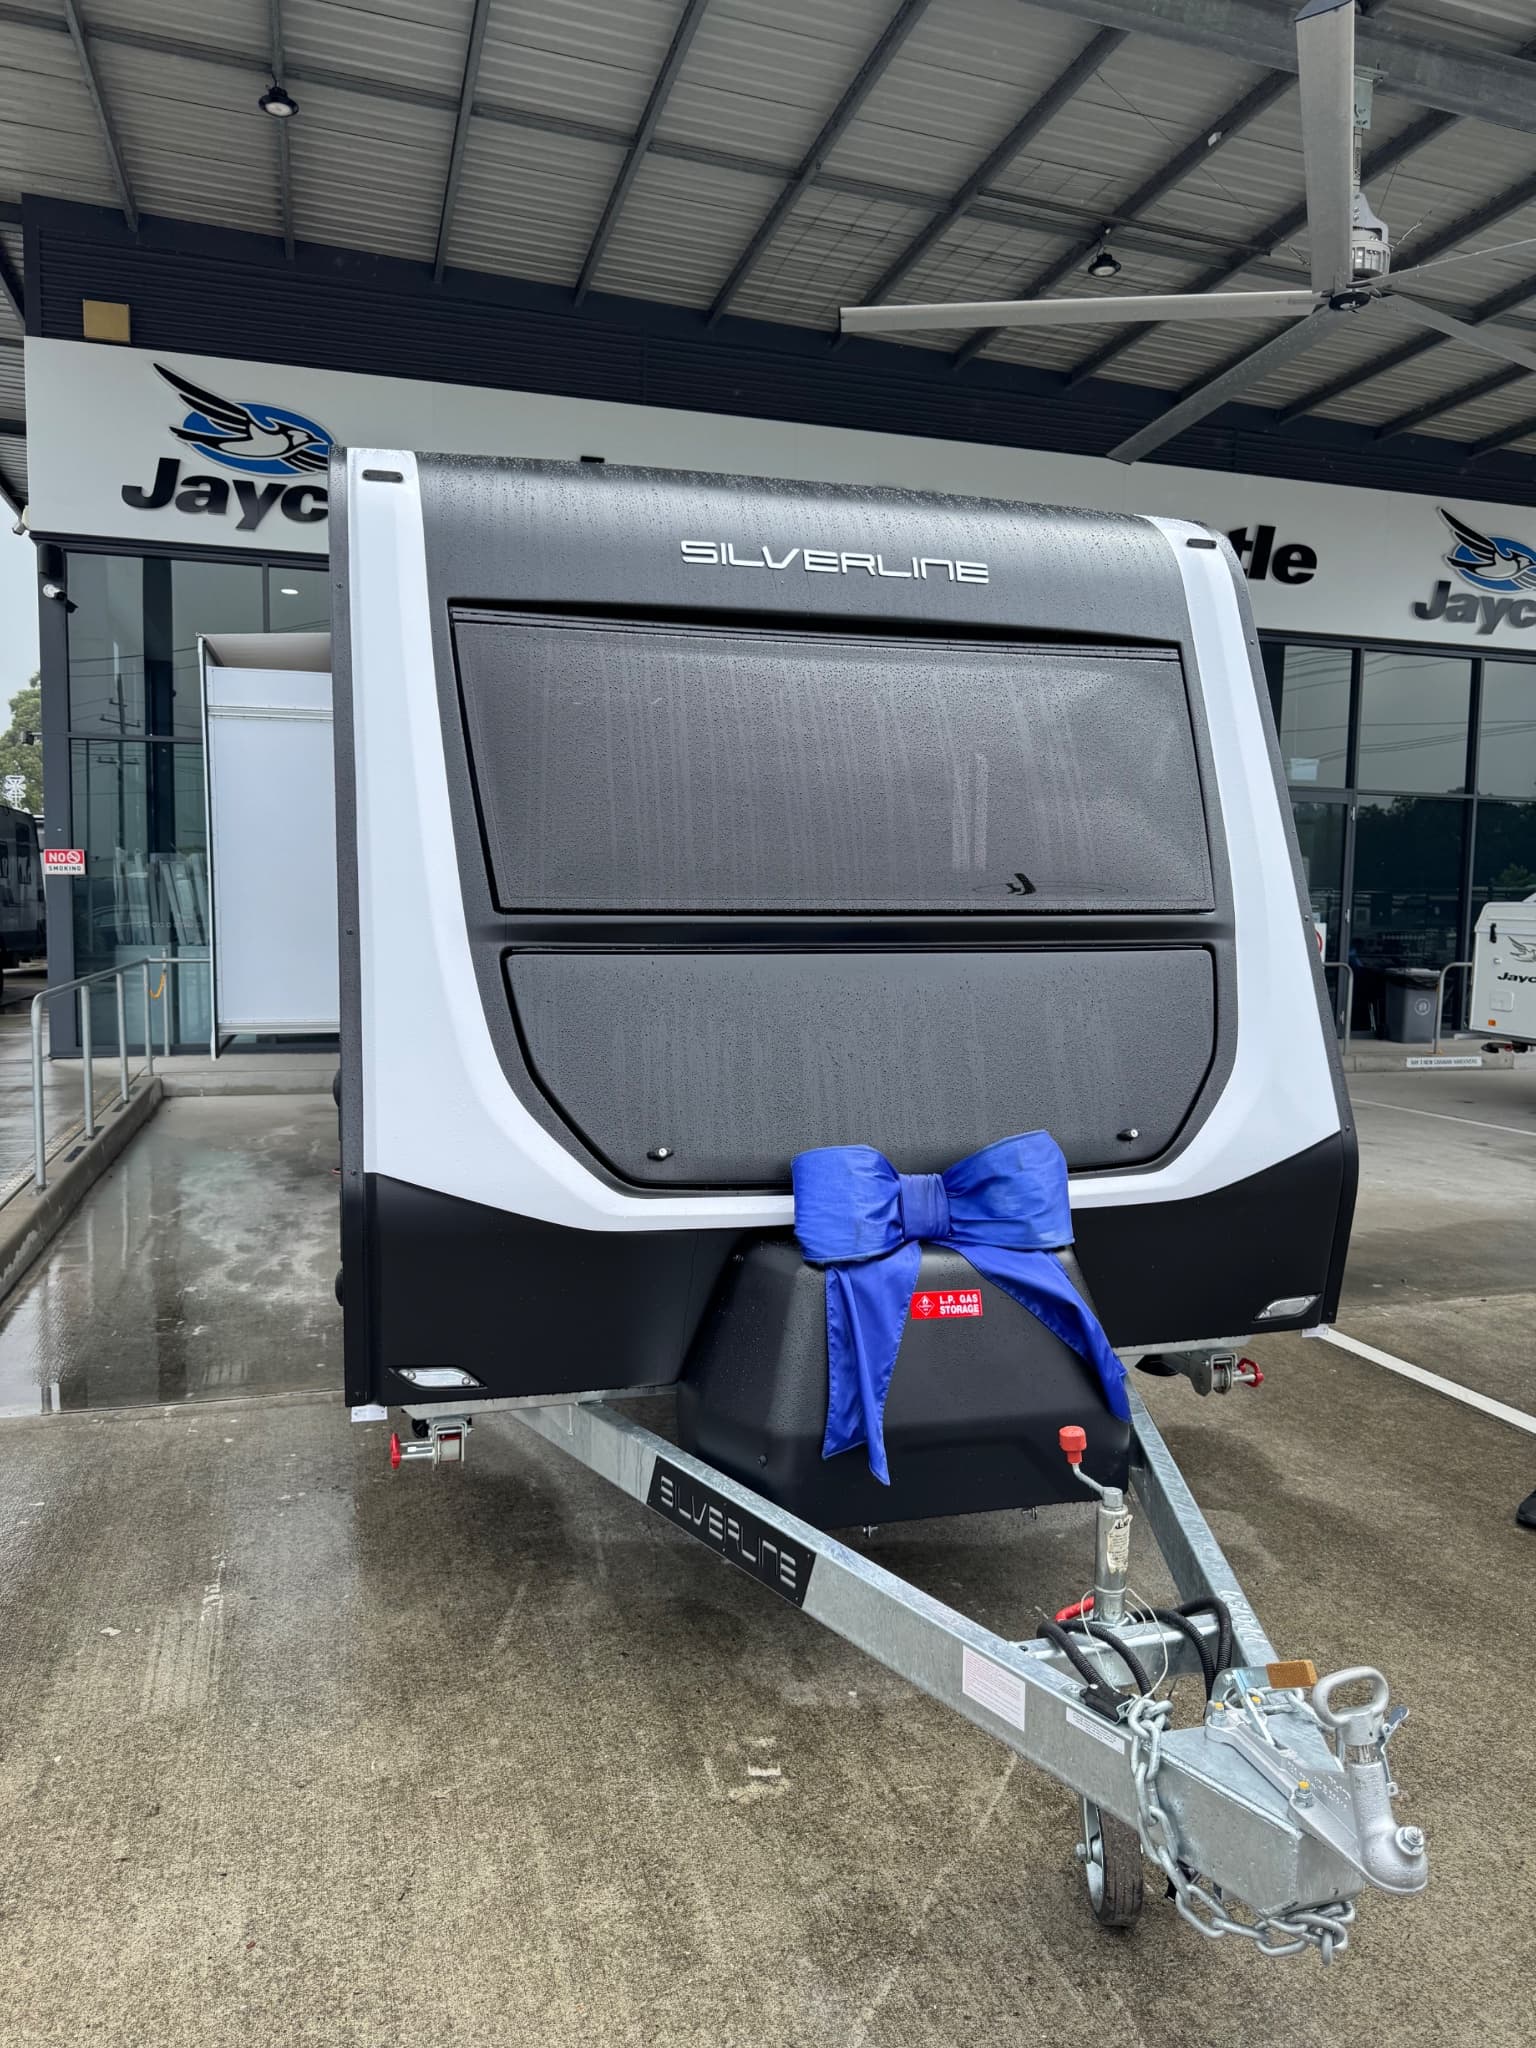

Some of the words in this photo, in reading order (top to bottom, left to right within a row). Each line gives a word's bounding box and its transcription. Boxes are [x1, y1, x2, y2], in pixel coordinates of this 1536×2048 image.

[121, 457, 329, 532] Jayc
[680, 539, 990, 585] SILVERLINE
[1413, 580, 1536, 635] Jayc
[48, 851, 66, 863] NO
[48, 864, 82, 872] SMOKING
[939, 1294, 956, 1305] L.P.
[959, 1293, 978, 1304] GAS
[940, 1304, 980, 1315] STORAGE
[660, 1475, 797, 1589] SILVERLINE
